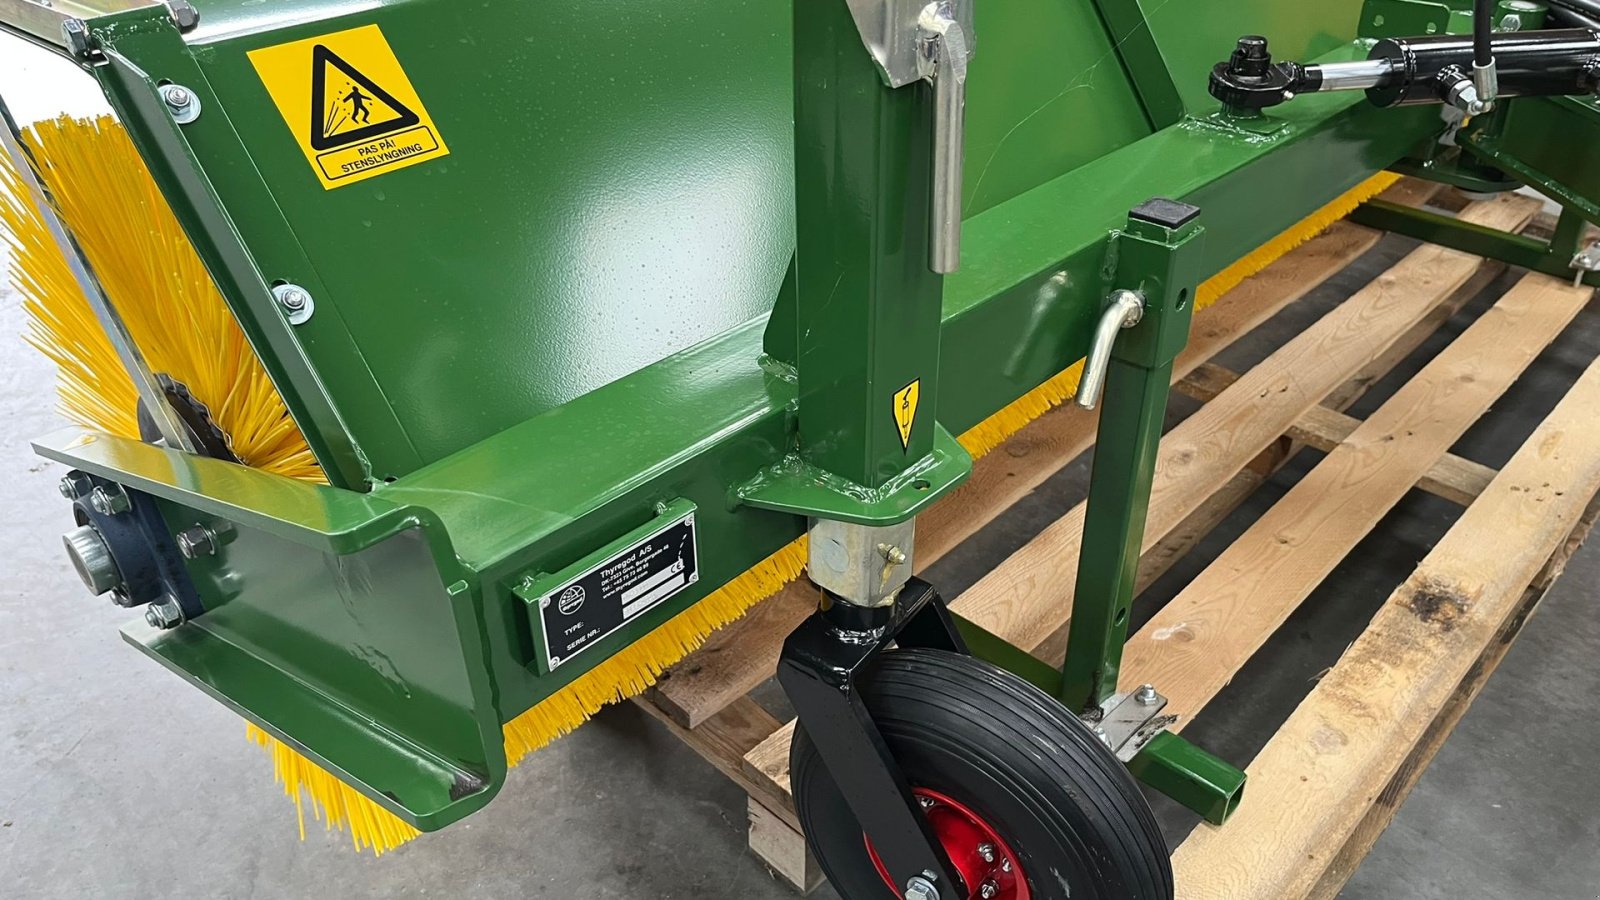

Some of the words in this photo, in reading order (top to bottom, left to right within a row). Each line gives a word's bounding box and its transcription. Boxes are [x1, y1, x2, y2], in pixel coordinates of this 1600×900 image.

[358, 144, 378, 156] PAS
[379, 139, 396, 150] PÅ!
[341, 144, 422, 172] STENSLYNGNING
[600, 554, 636, 578] Thyregod
[639, 544, 652, 557] A/S
[564, 622, 584, 636] TYPE:
[566, 635, 586, 650] SERIE
